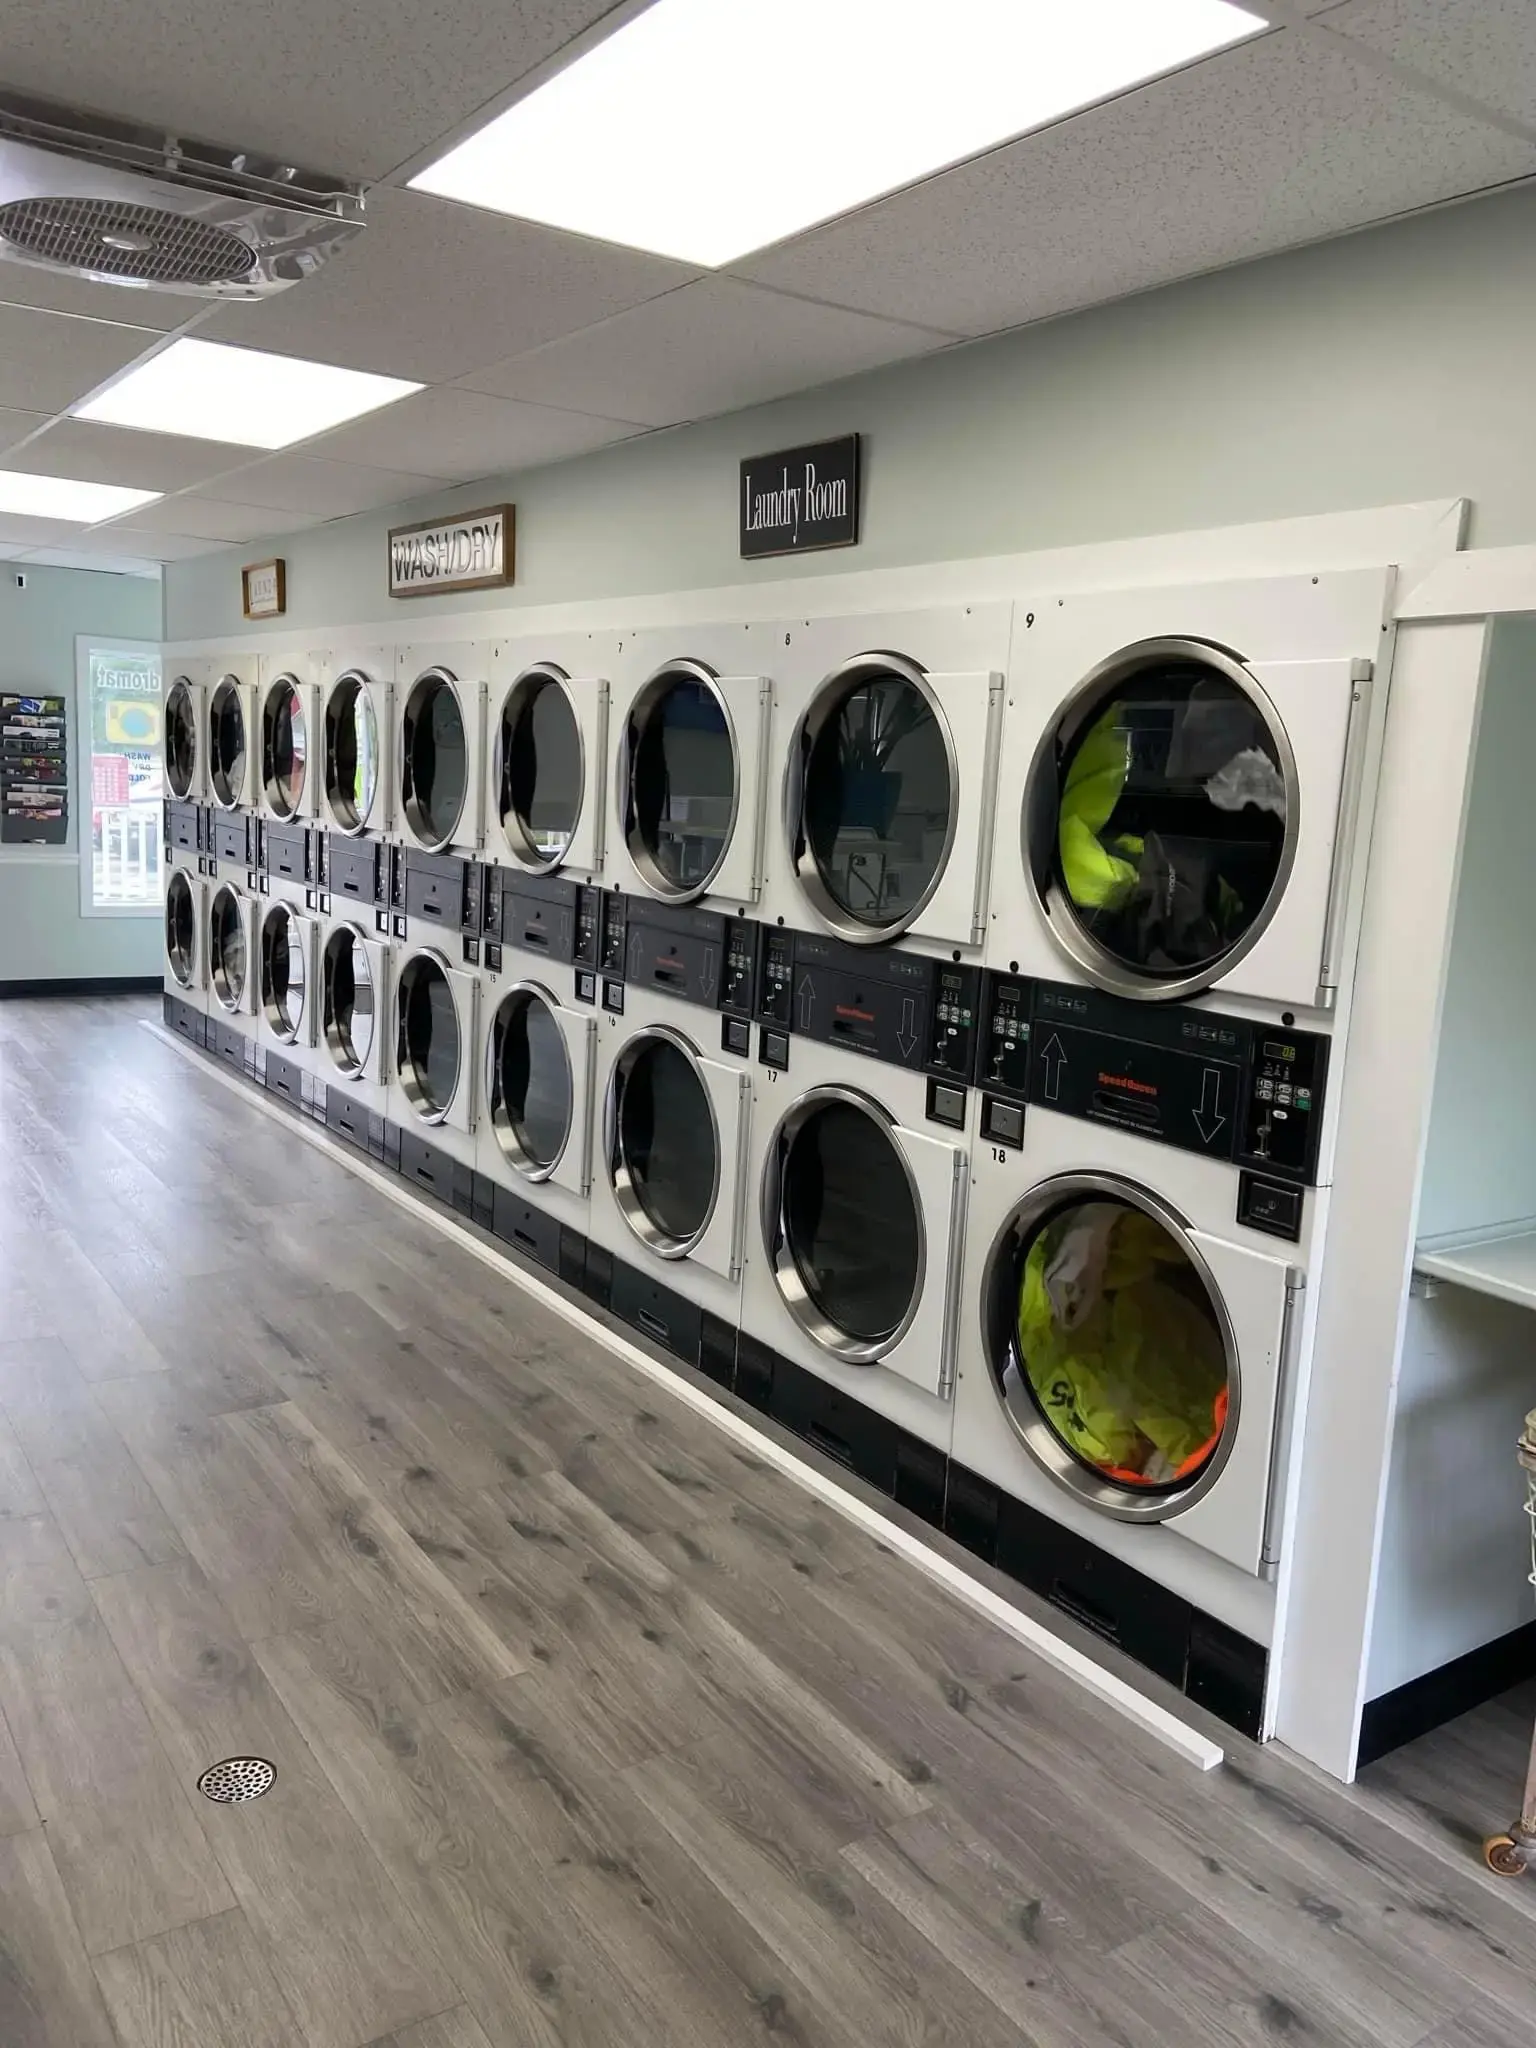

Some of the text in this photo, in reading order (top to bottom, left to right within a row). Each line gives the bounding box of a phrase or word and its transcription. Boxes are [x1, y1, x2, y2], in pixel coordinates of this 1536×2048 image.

[744, 463, 848, 544] Laundry Room
[1025, 612, 1035, 629] 9
[785, 632, 791, 646] 8
[618, 641, 624, 654] 7
[489, 973, 497, 984] 15
[608, 1015, 616, 1027] 16
[767, 1069, 778, 1083] 17
[991, 1147, 1006, 1164] 18
